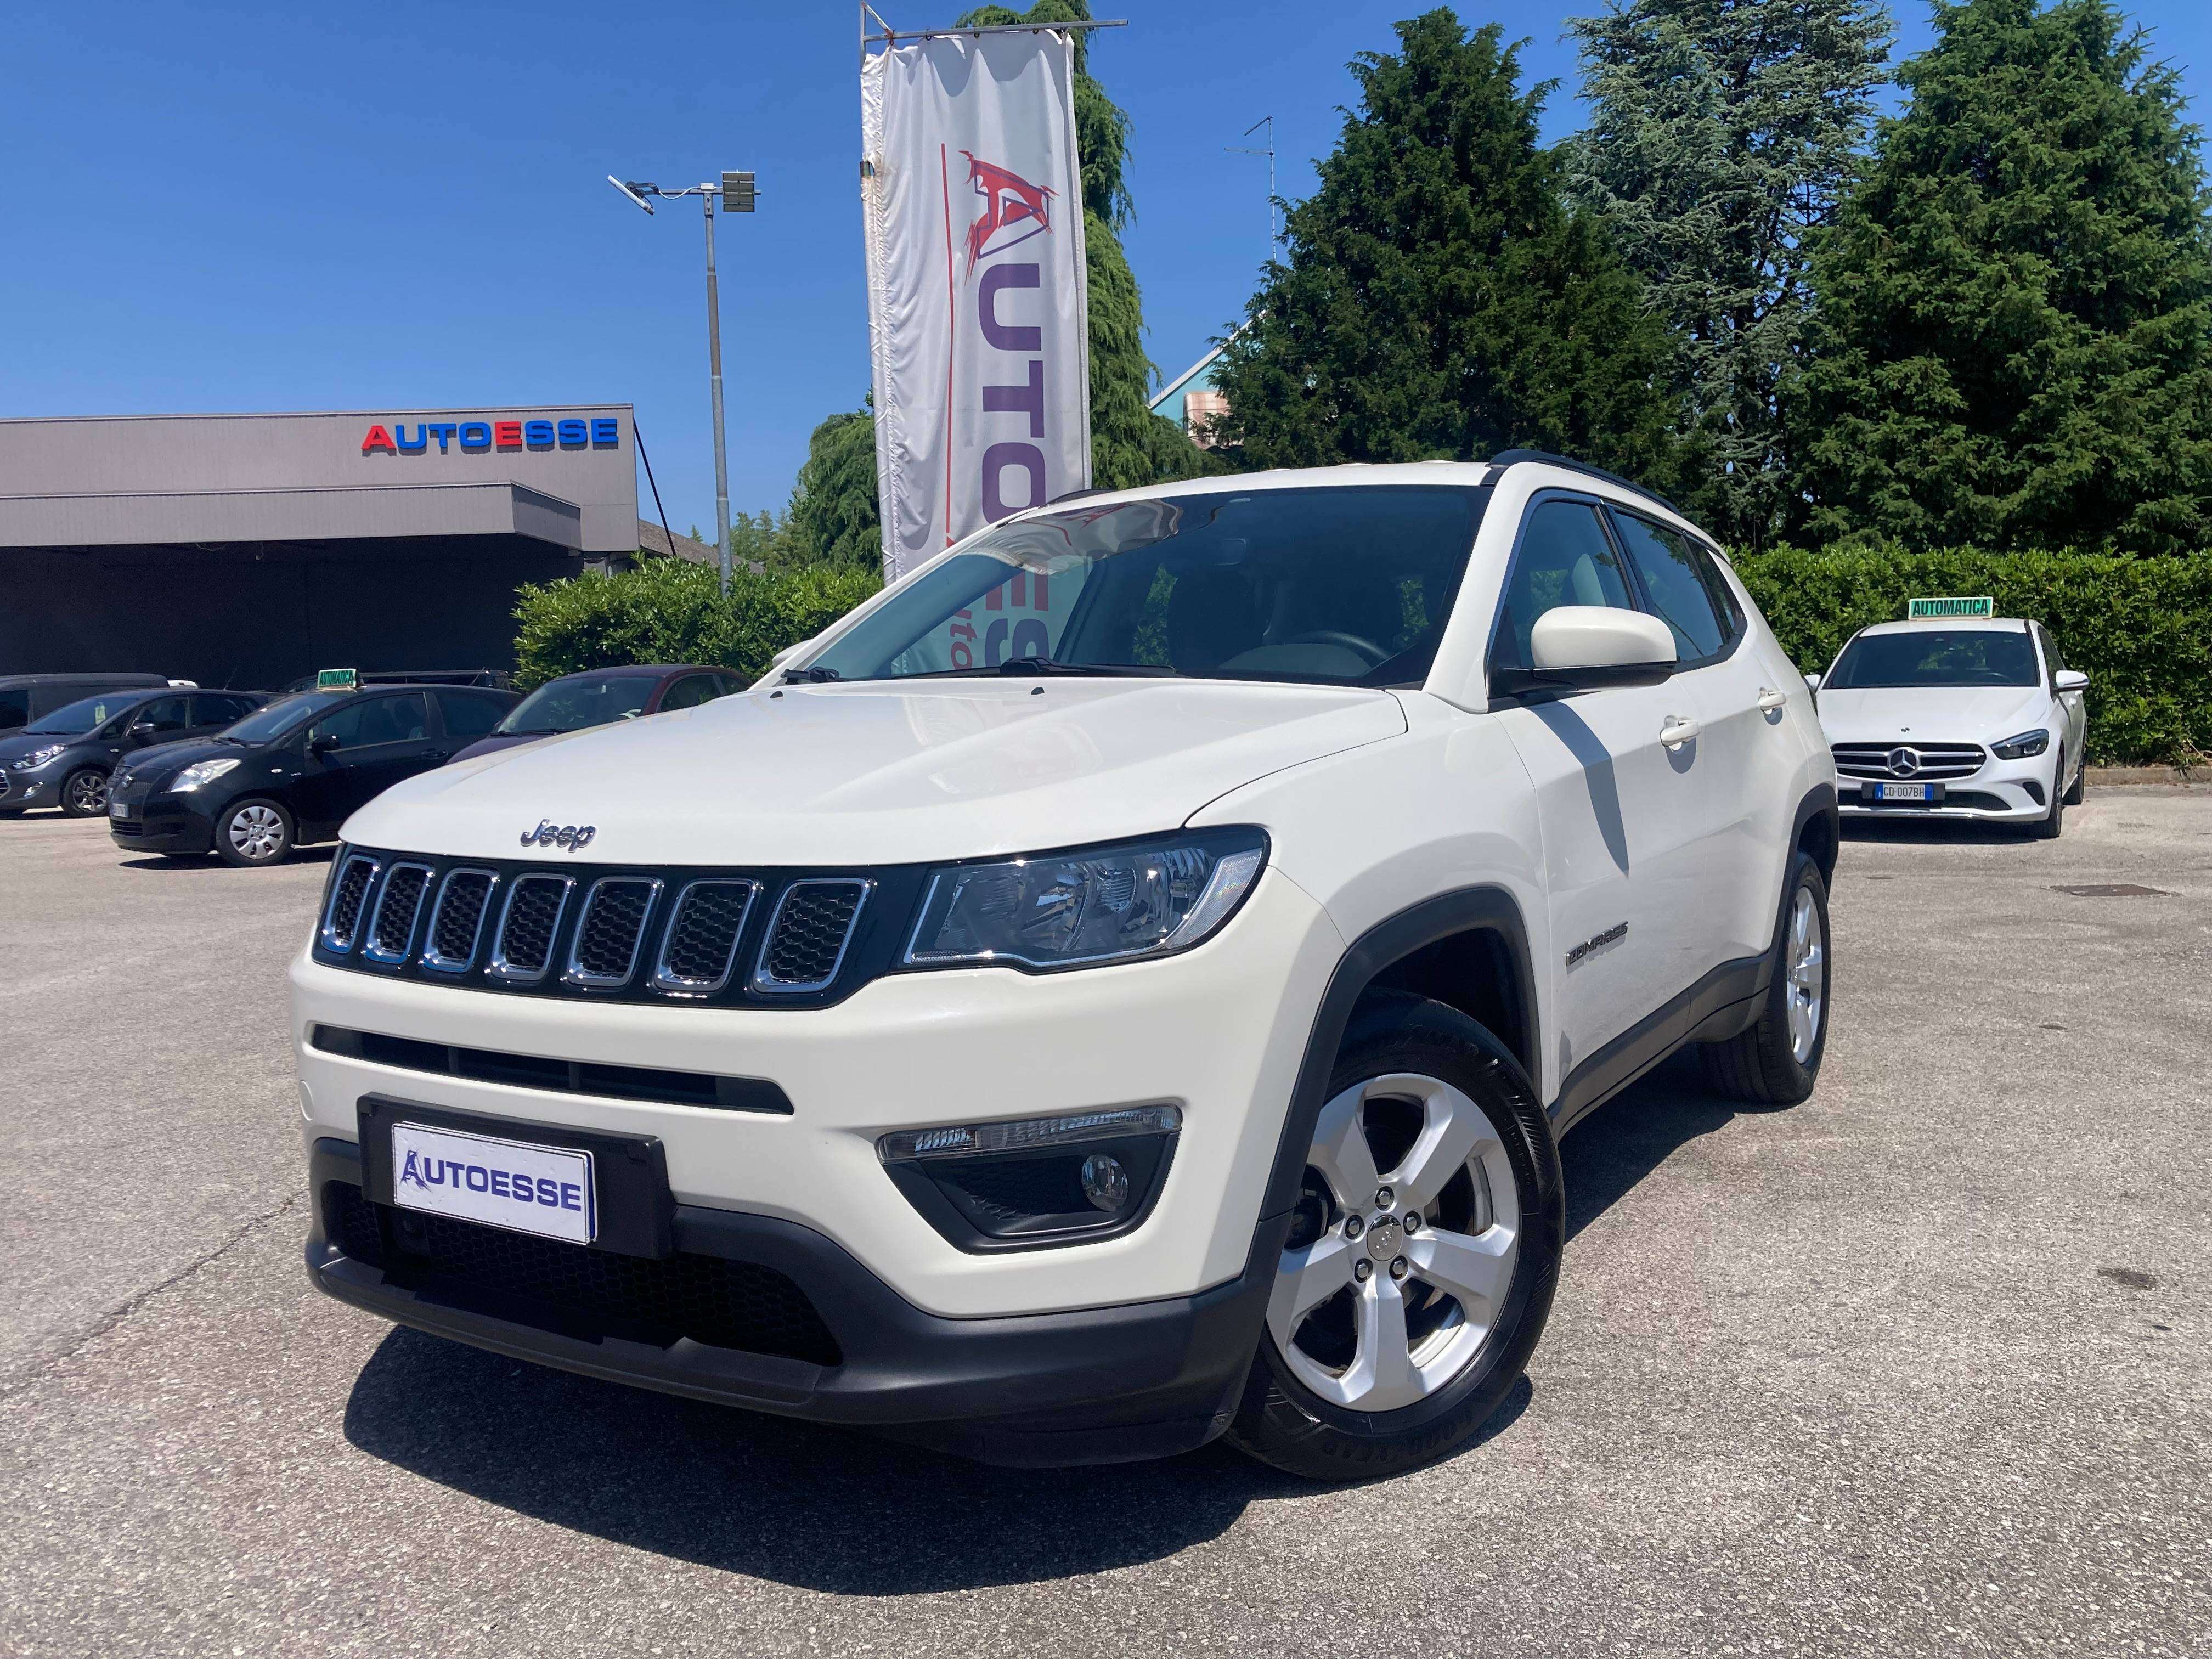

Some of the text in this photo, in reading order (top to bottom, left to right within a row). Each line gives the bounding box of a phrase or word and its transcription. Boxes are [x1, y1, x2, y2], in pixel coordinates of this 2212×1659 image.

[360, 418, 619, 449] AUTOESSE
[1912, 599, 1989, 616] AUTOMATICA
[521, 819, 596, 853] Jeep
[400, 1150, 582, 1211] AUTOESSE
